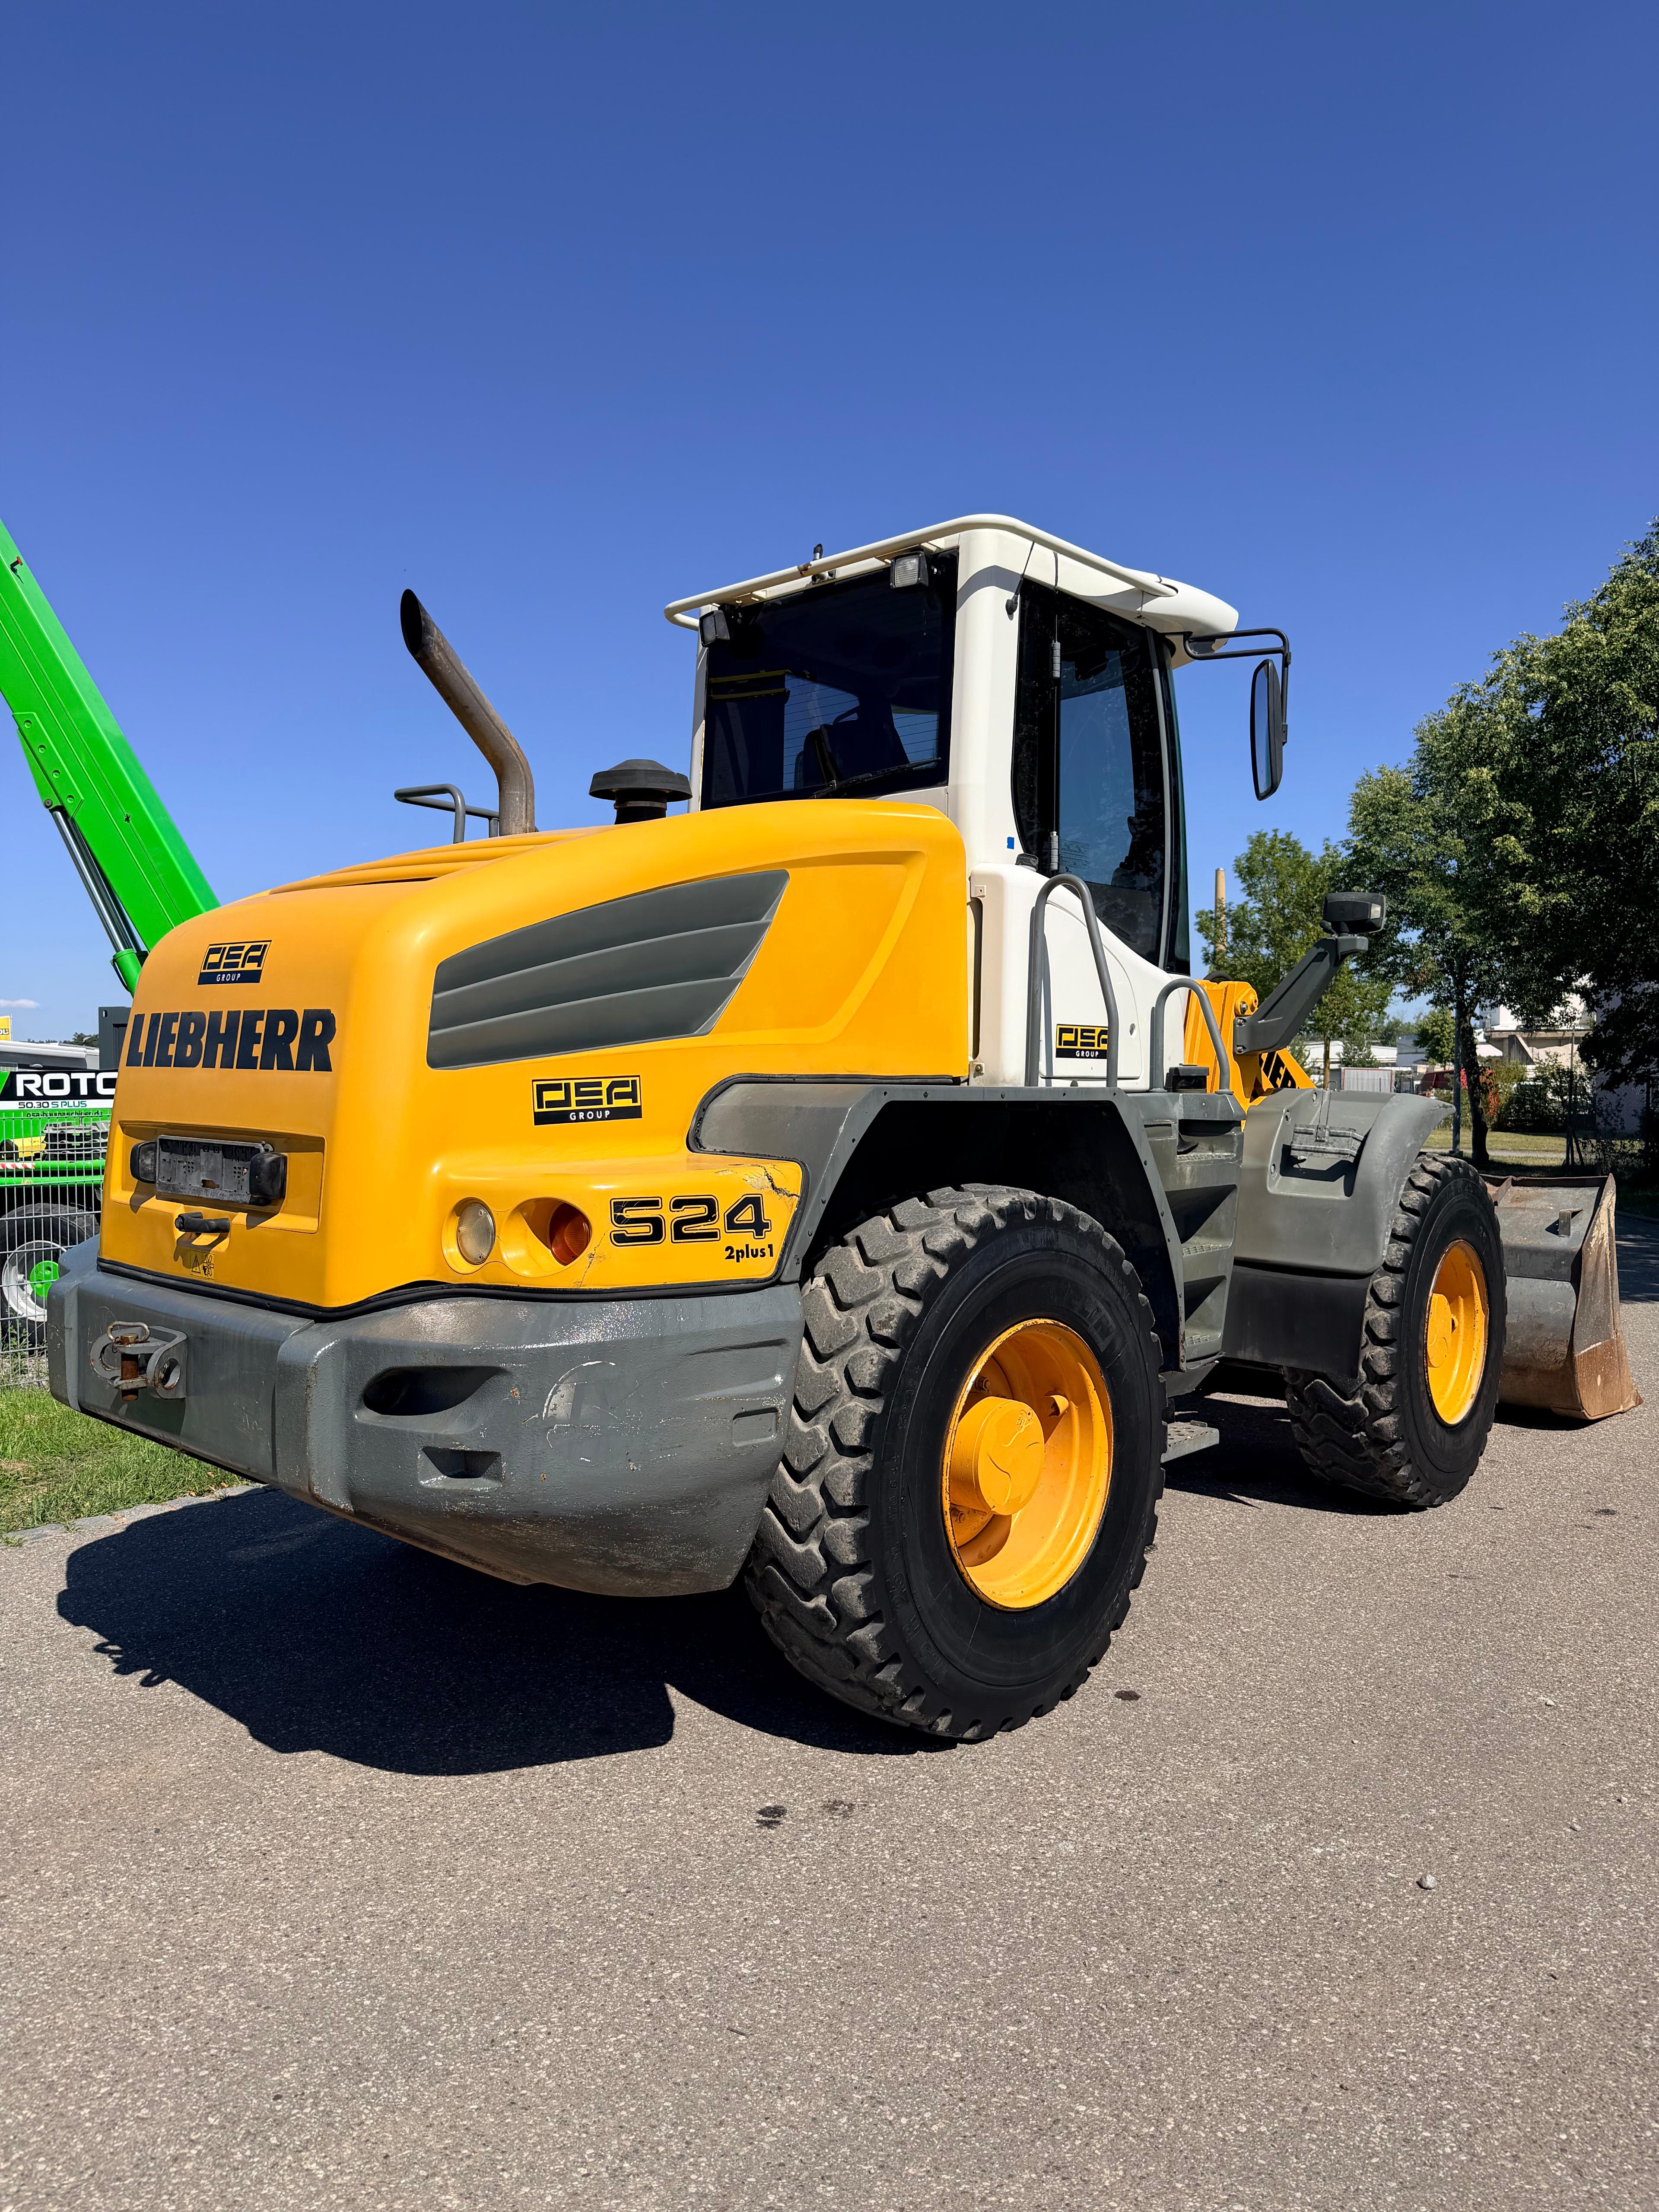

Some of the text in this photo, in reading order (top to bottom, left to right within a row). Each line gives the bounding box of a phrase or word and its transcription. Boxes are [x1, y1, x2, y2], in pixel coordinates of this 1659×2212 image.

[216, 973, 241, 982] GROUP
[126, 1009, 336, 1072] LIEBHERR
[569, 1110, 610, 1120] GROUP
[610, 1194, 772, 1247] 524
